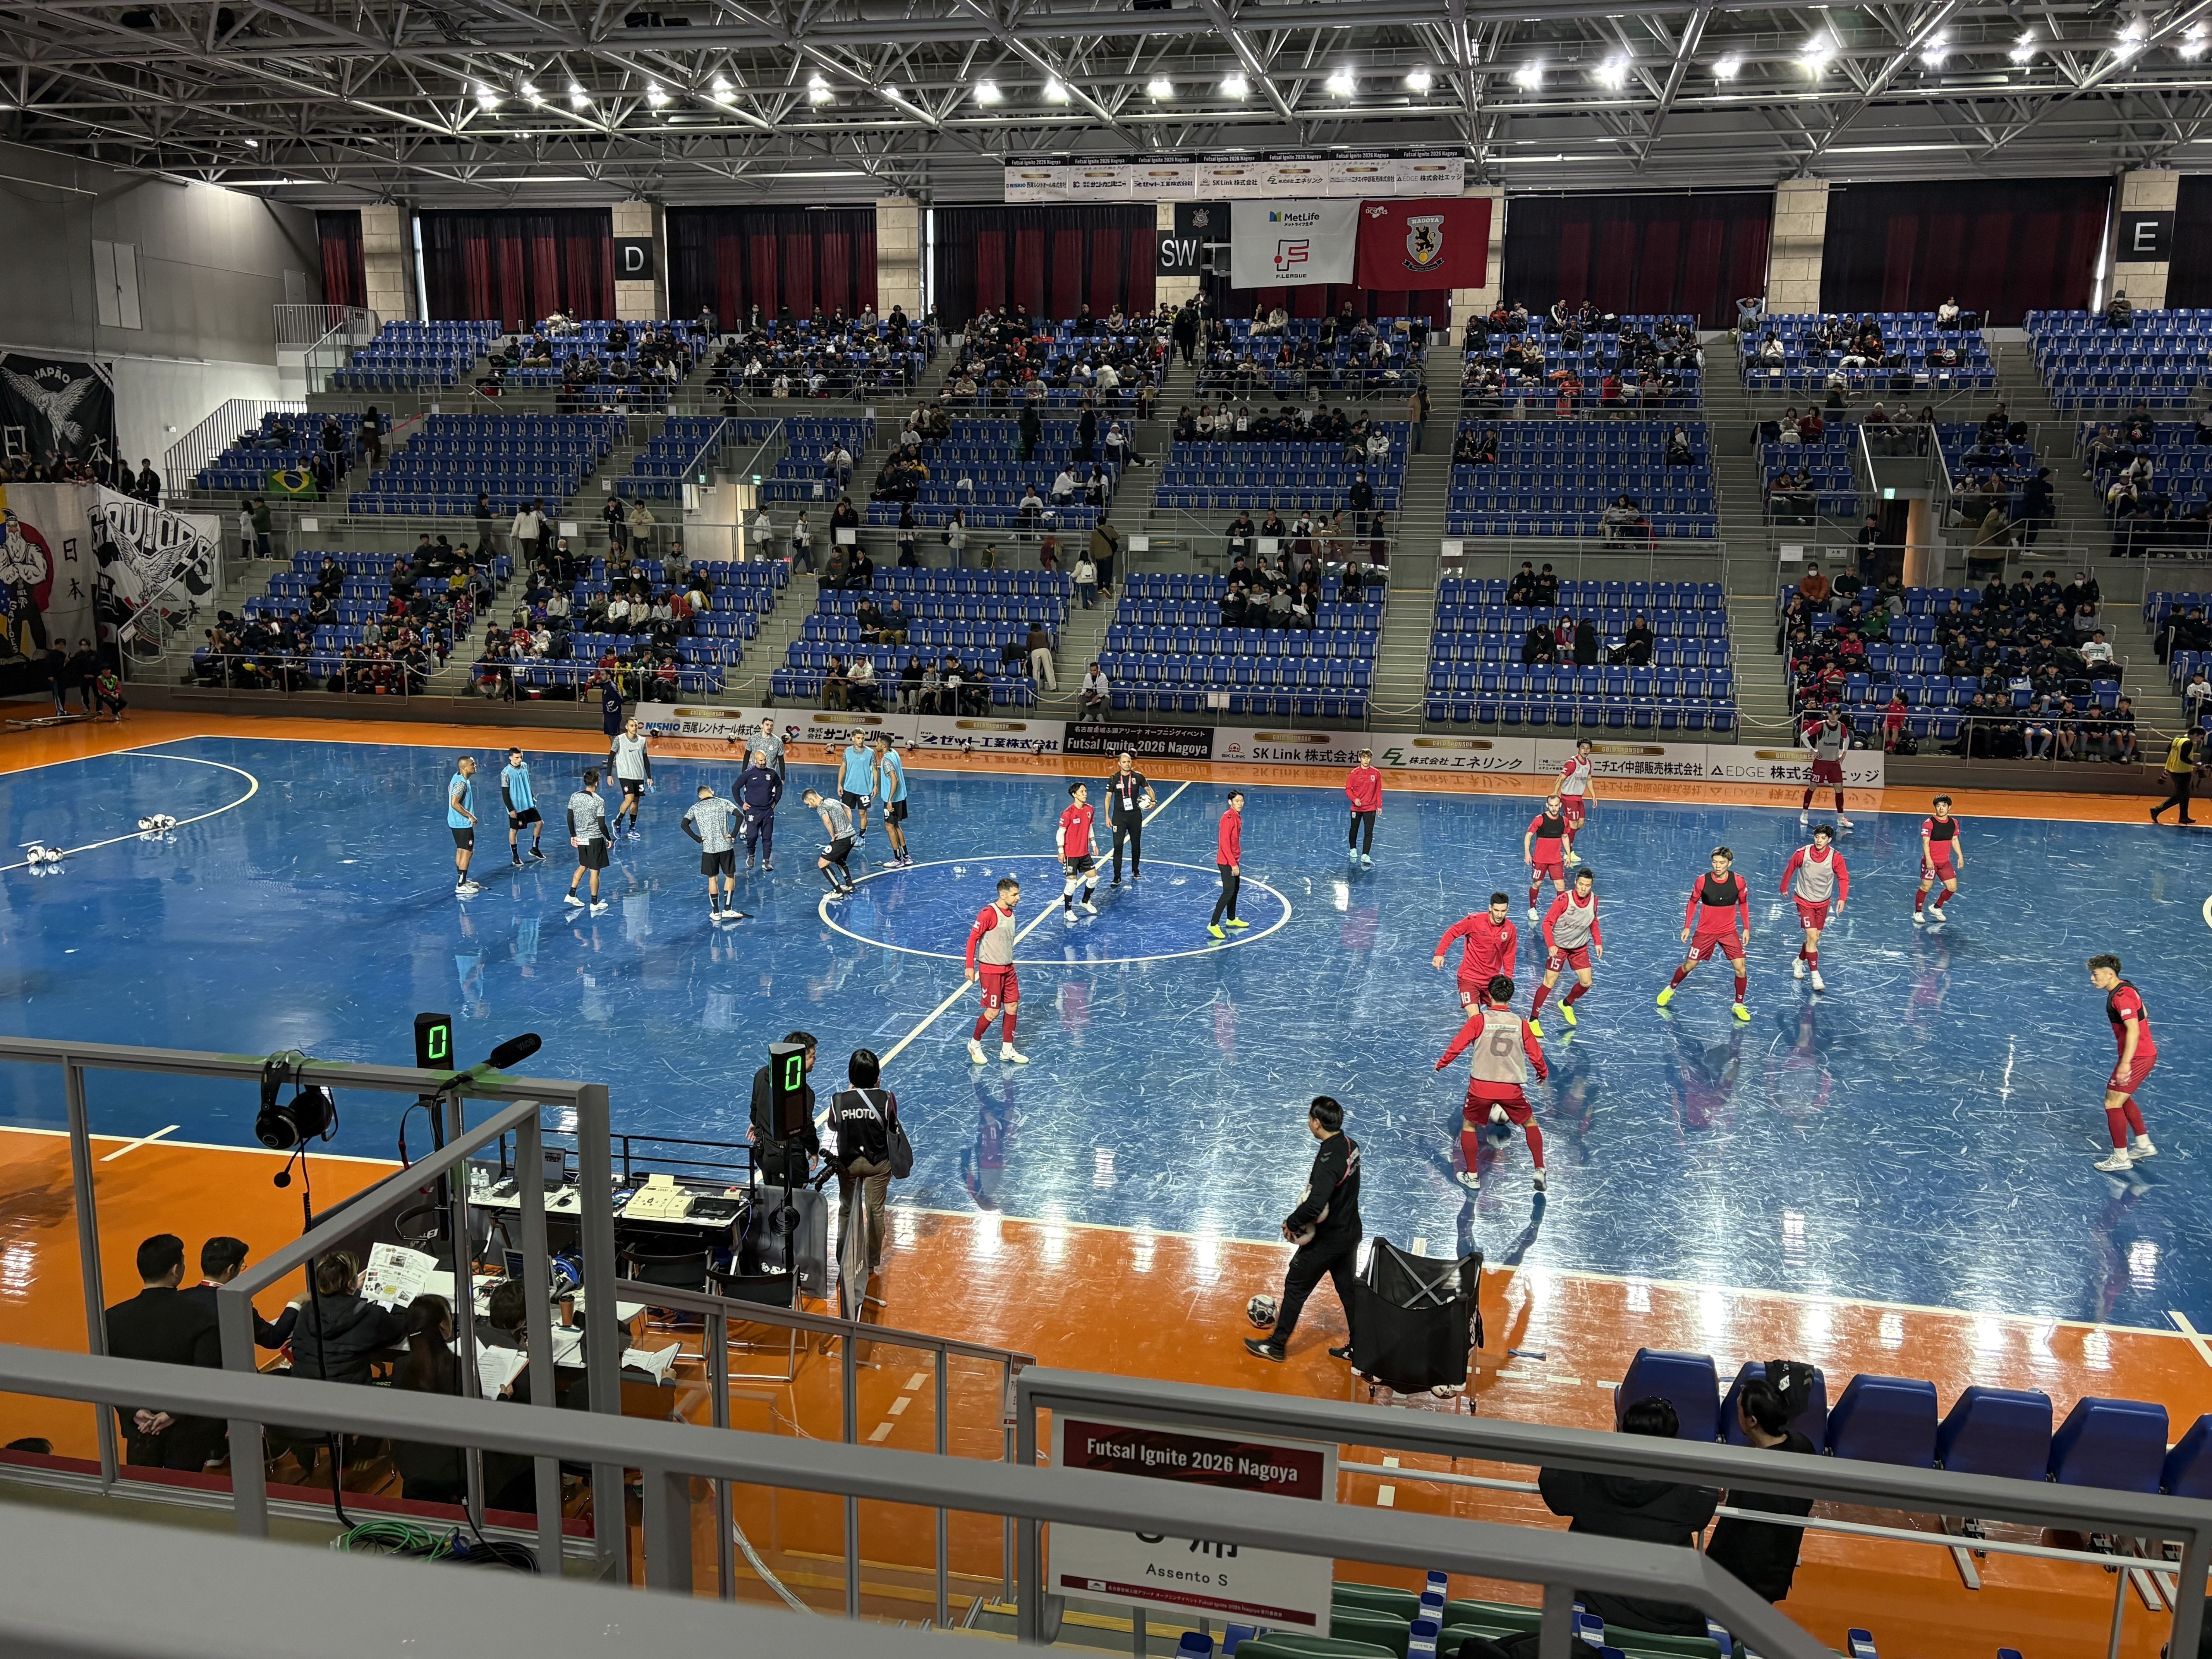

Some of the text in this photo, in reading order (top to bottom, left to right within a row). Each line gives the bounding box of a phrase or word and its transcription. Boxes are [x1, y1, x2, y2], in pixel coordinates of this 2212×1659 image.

[1284, 212, 1320, 222] MetLife
[2133, 222, 2158, 251] E
[625, 247, 644, 271] D
[1161, 239, 1197, 267] SW
[34, 366, 70, 383] JAPÃO
[646, 722, 680, 731] NISHIO
[1075, 726, 1143, 735] 名古屋金城ふ頭アリーナ
[1067, 737, 1208, 756] Futsal Ignite 2026 Nagoya
[1252, 748, 1361, 763] SK Link 株式会社
[1409, 756, 1523, 769] 株式会社 エネリンク
[1594, 761, 1703, 776] ニチエイ中部販売株式会社
[1726, 766, 1765, 778] EDGE
[860, 795, 870, 804] 12
[1533, 869, 1541, 879] 10
[1925, 869, 1935, 879] 29
[1688, 946, 1700, 959] 19
[1550, 957, 1560, 970] 15
[1460, 991, 1470, 1004] 18
[429, 1025, 446, 1059] 0
[1490, 1029, 1513, 1057] 6
[785, 1055, 802, 1091] 0
[842, 1108, 876, 1120] PHOTO
[1087, 1438, 1298, 1484] Futsal Ignite 2026 Nagoya
[1146, 1563, 1228, 1586] Assento S
